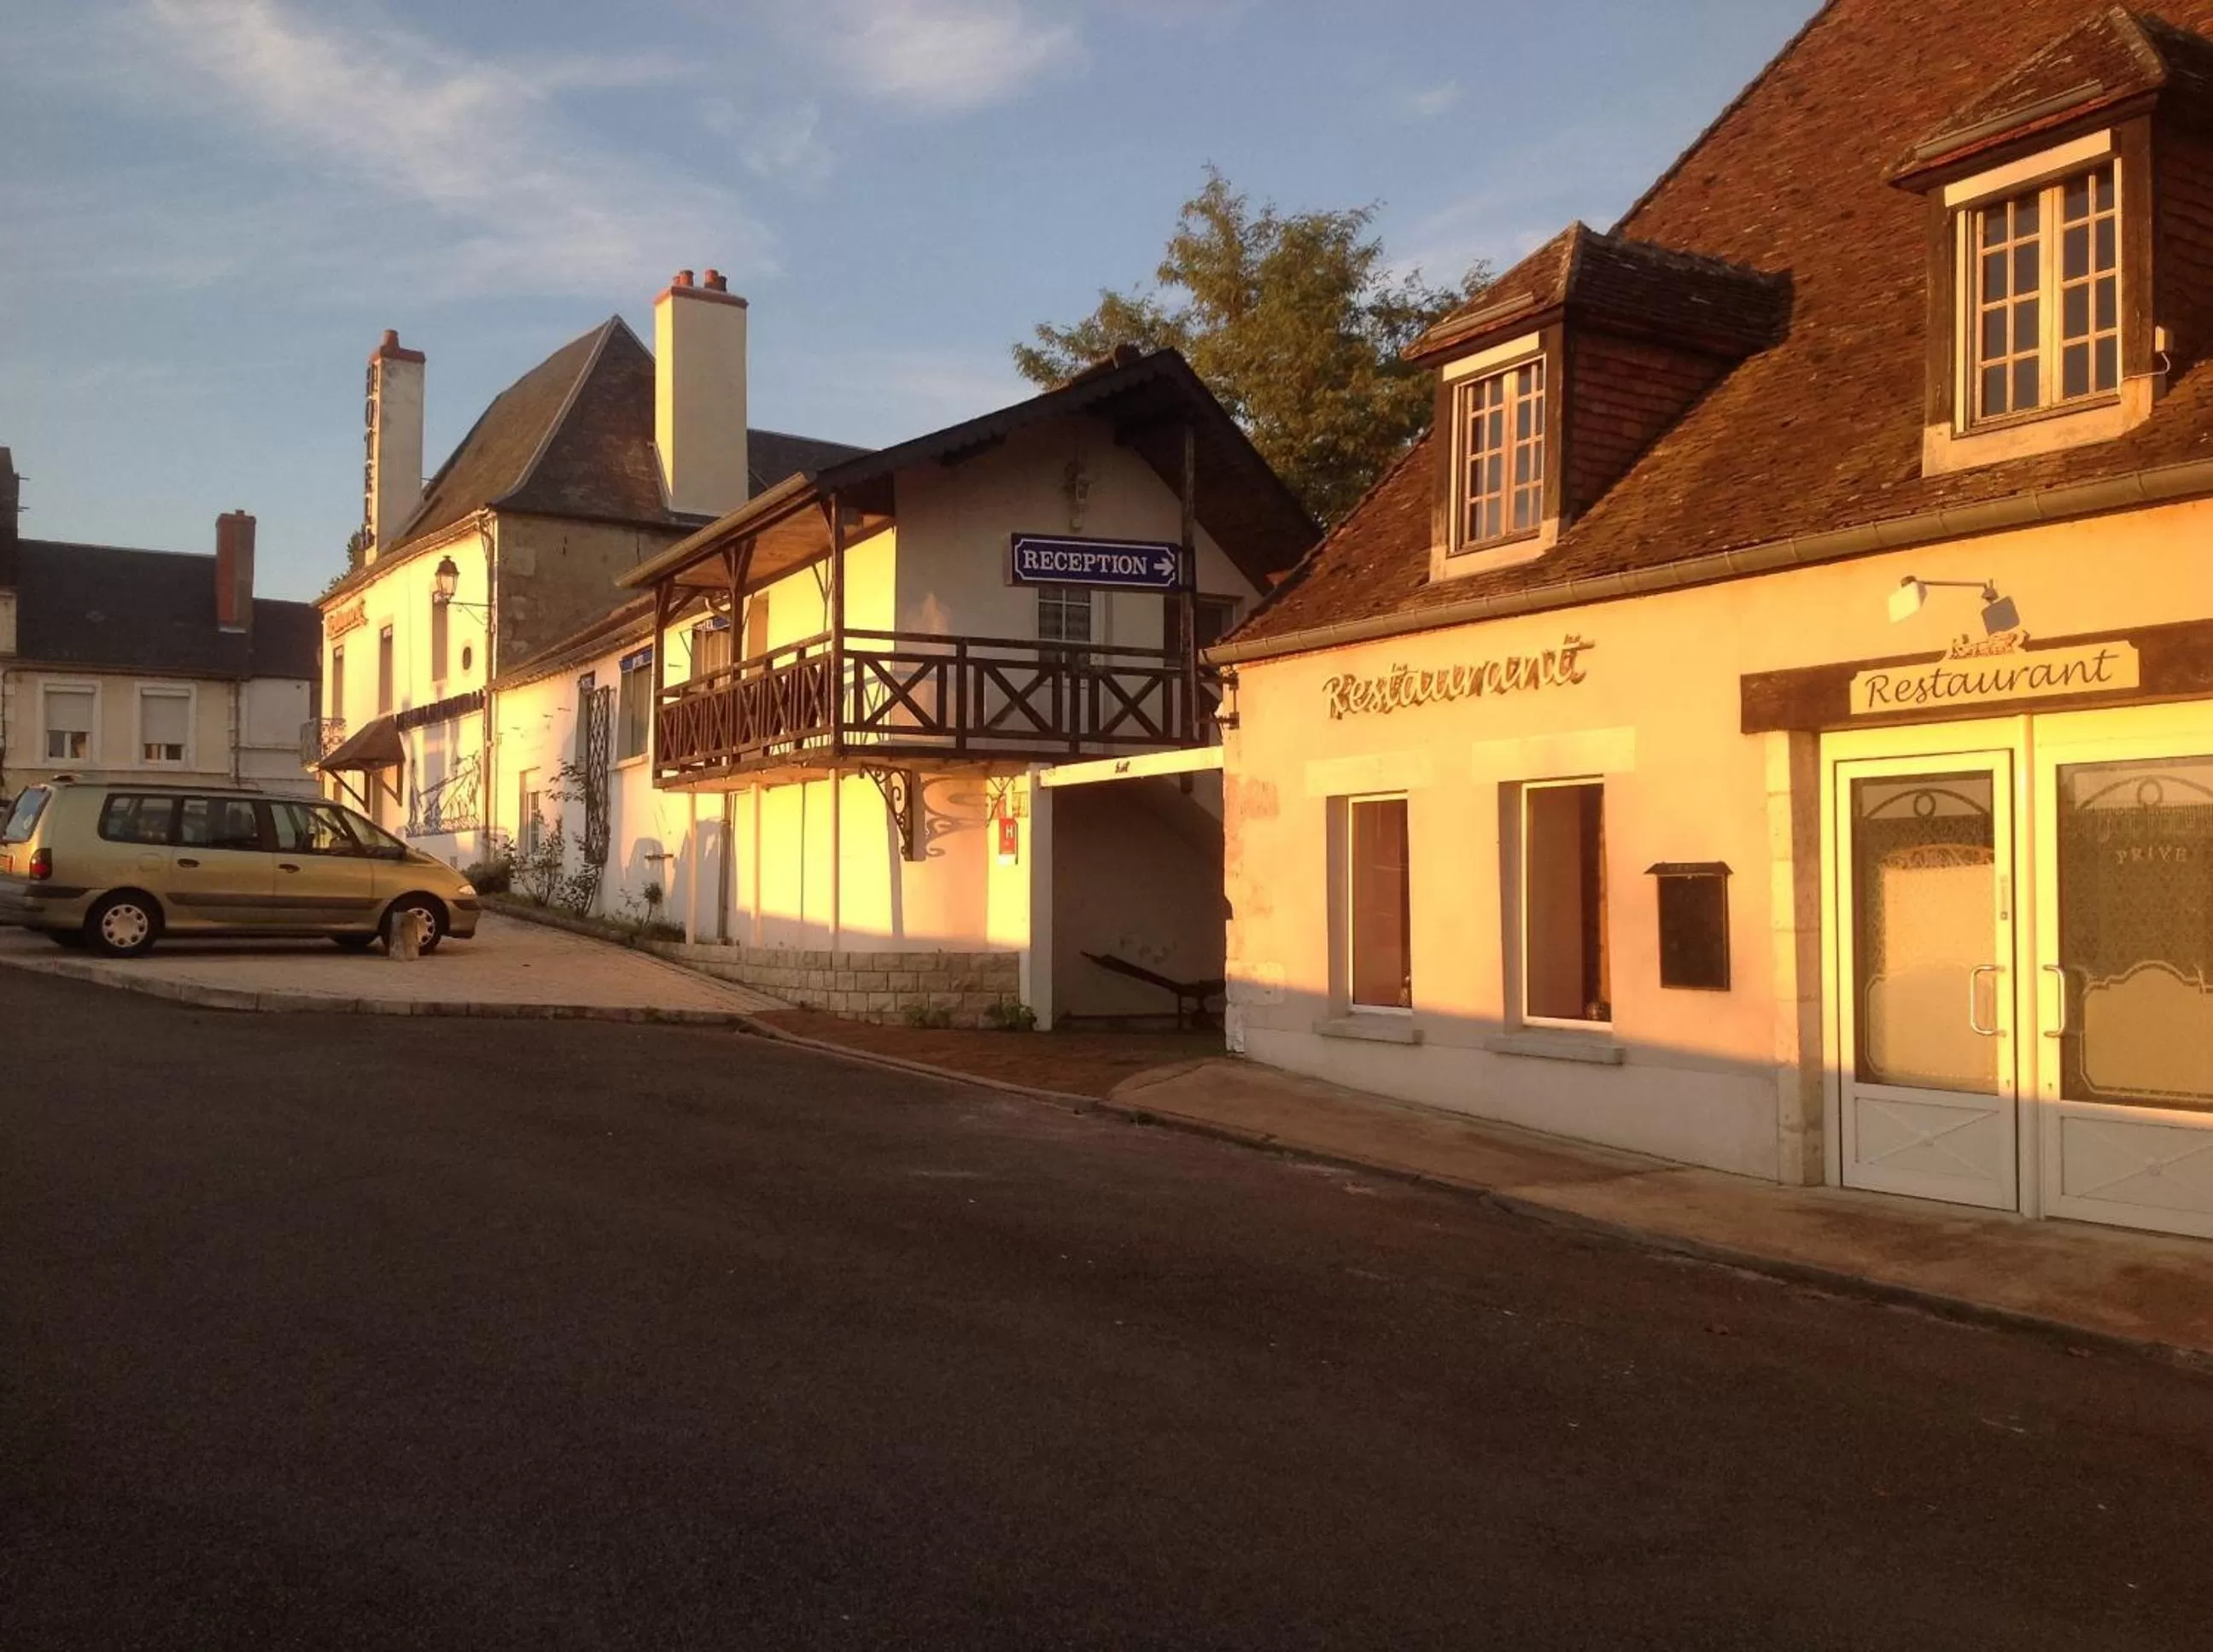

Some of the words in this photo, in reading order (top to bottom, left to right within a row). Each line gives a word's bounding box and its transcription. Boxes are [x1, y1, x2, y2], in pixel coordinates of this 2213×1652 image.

[1023, 550, 1147, 575] RECEPTION
[1323, 635, 1592, 719] Restaurant
[1865, 649, 2120, 708] Restaurant
